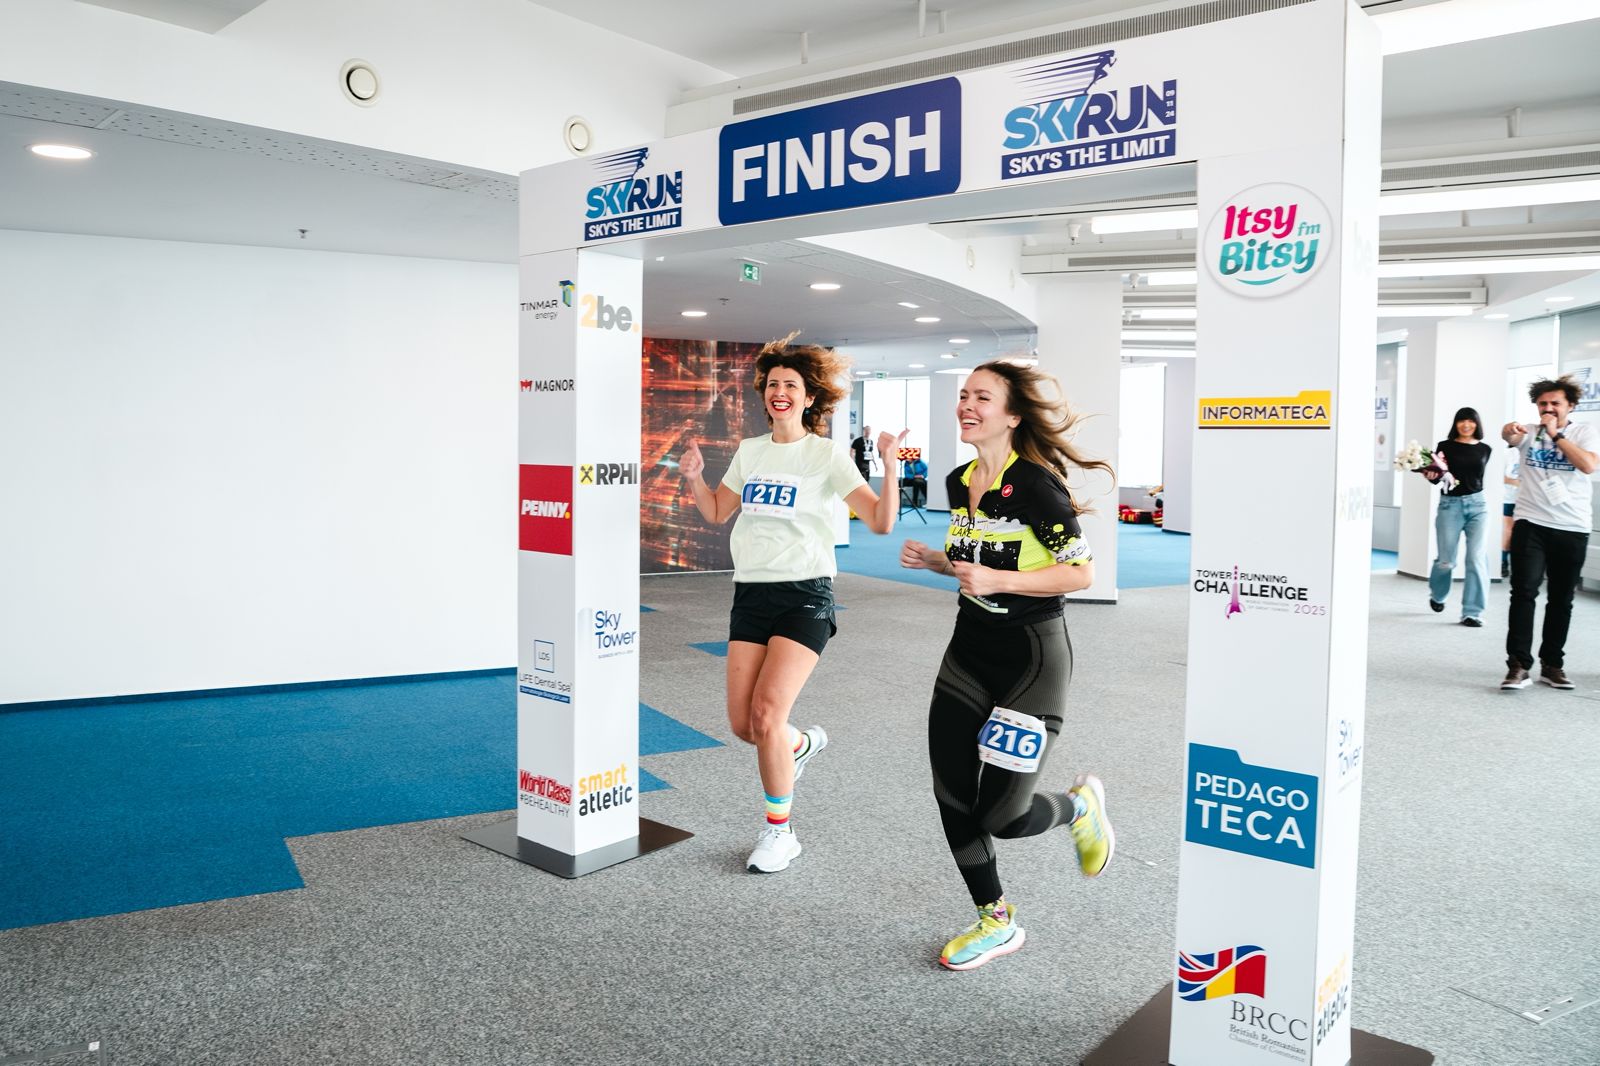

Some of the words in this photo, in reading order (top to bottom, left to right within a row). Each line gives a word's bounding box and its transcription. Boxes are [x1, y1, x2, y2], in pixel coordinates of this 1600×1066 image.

[733, 110, 941, 203] FINISH
[1009, 153, 1063, 175] SKY'S
[1066, 145, 1107, 167] THE
[1111, 135, 1170, 160] LIMIT
[588, 221, 619, 238] SKY'S
[621, 217, 644, 233] THE
[645, 211, 679, 229] LIMIT
[1224, 204, 1297, 240] Itsy
[1298, 221, 1321, 237] fm
[1219, 238, 1319, 275] Bitsy
[520, 300, 558, 311] TINMAR
[535, 312, 558, 320] energy
[581, 294, 640, 333] 2be.
[535, 379, 574, 392] MAGNOR
[1203, 405, 1327, 420] INFORMATECA
[596, 463, 638, 485] RPHI
[753, 485, 792, 506] 215
[521, 499, 570, 519] PENNY.
[1196, 570, 1232, 579] TOWER
[1240, 573, 1288, 584] RUNNING
[1194, 579, 1308, 601] CHALLENGE
[595, 610, 621, 630] Sky
[1294, 604, 1326, 616] 2025
[595, 631, 637, 649] Tower
[987, 724, 1037, 756] 216
[520, 769, 546, 796] World
[546, 778, 571, 805] Class
[578, 763, 627, 795] smart
[1196, 772, 1309, 811] PEDAGO
[520, 793, 570, 817] #BEHEALTHY
[579, 785, 633, 816] atletic
[1194, 798, 1306, 849] TECA
[1231, 1000, 1308, 1041] BRCC
[1230, 1024, 1259, 1040] British
[1261, 1034, 1306, 1055] Romanian
